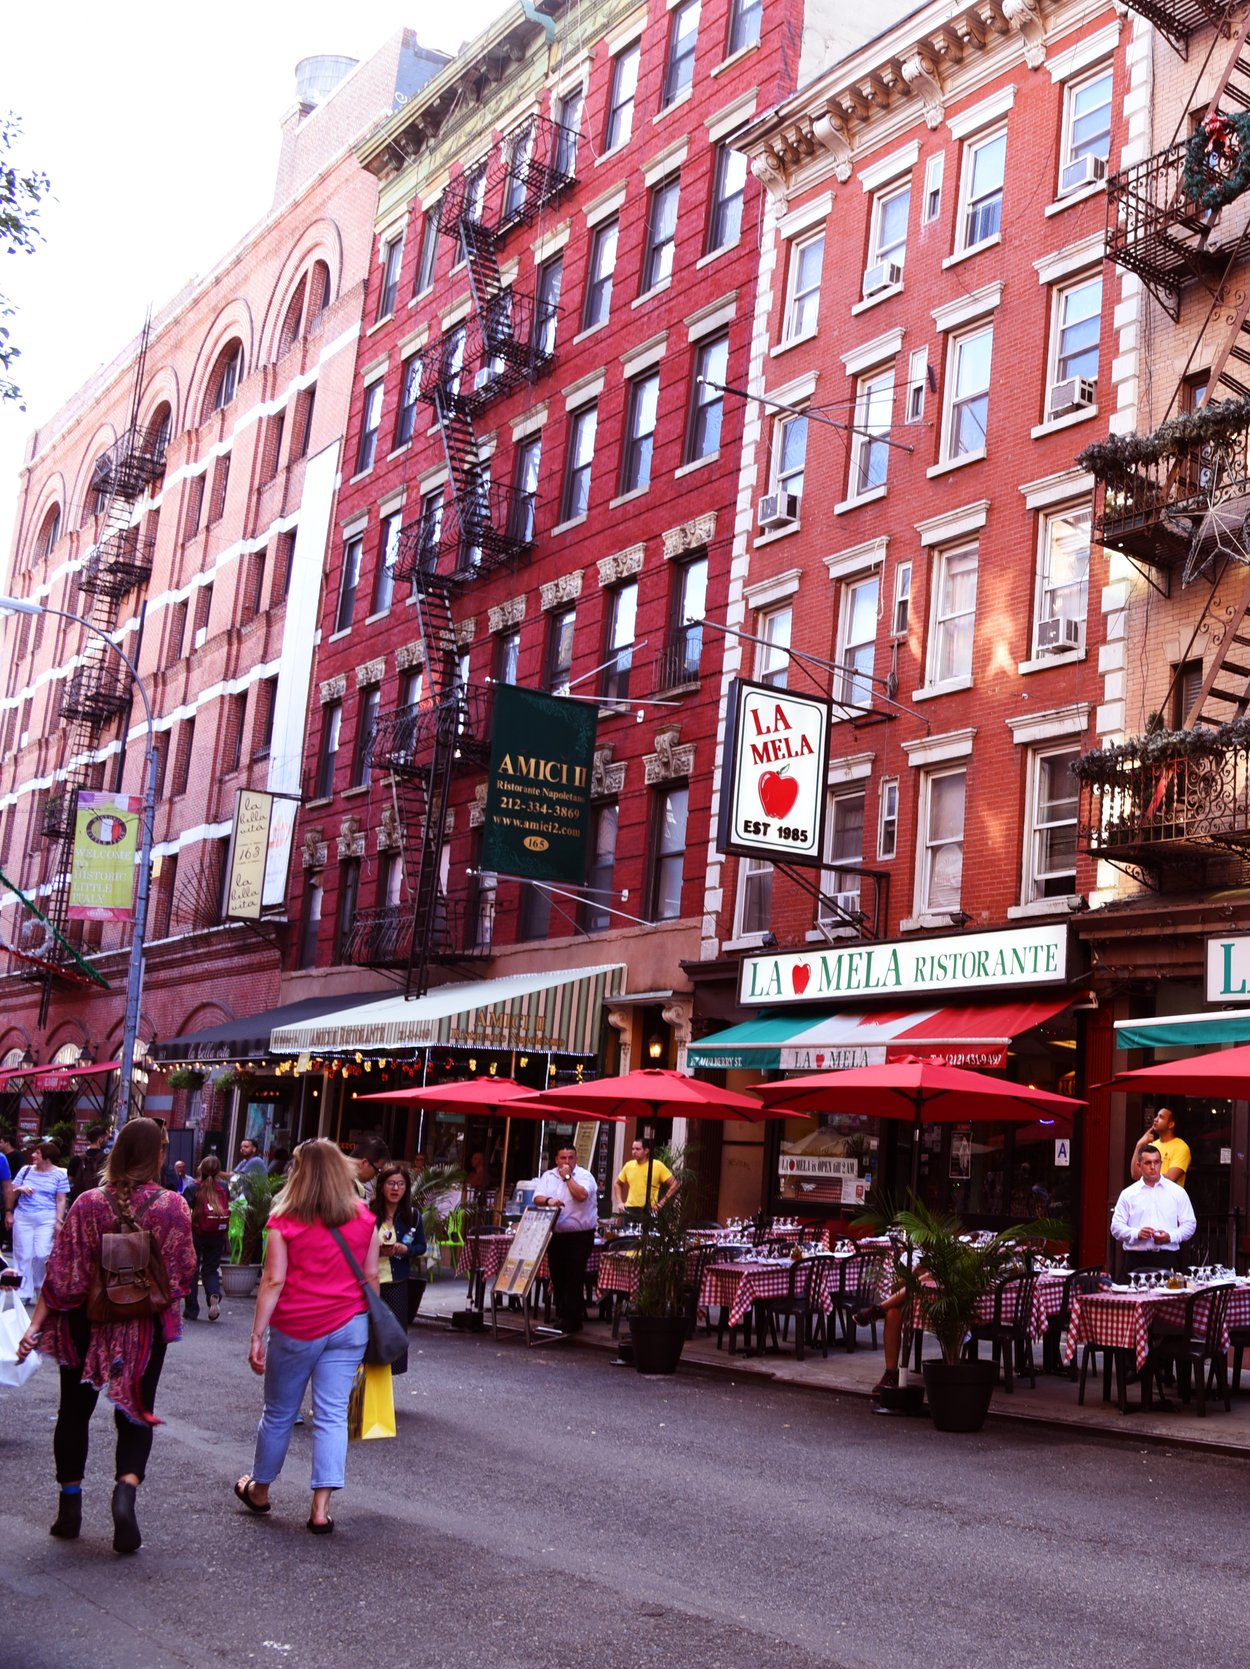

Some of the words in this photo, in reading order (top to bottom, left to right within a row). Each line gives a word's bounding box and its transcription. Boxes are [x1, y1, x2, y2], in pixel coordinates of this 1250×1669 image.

[750, 704, 792, 736] LA
[750, 734, 815, 765] MELA
[498, 753, 568, 785] AMICI
[574, 766, 587, 787] II
[496, 780, 541, 796] Ristorante
[244, 798, 261, 811] la
[500, 796, 580, 819] 212-334-3869
[240, 812, 267, 825] bella
[240, 823, 265, 835] vita
[493, 815, 581, 837] www.amici2.com
[744, 820, 771, 836] EST
[777, 826, 808, 842] 1985
[528, 838, 545, 849] 165
[75, 848, 131, 859] WELCOME
[240, 846, 261, 860] 163
[75, 871, 127, 882] HISTORIC
[235, 873, 252, 887] la
[73, 881, 113, 893] LITTLE
[231, 887, 259, 901] bella
[73, 892, 105, 904] ITALY
[231, 898, 257, 911] vita
[749, 960, 783, 997] LA
[818, 948, 902, 993] MELA
[914, 943, 1059, 983] RISTORANTE
[474, 1009, 530, 1031] AMICI
[794, 1051, 811, 1069] LA
[829, 1049, 869, 1069] MELA
[1057, 1142, 1067, 1158] A
[818, 1161, 832, 1173] OPEN
[847, 1162, 855, 1174] AM
